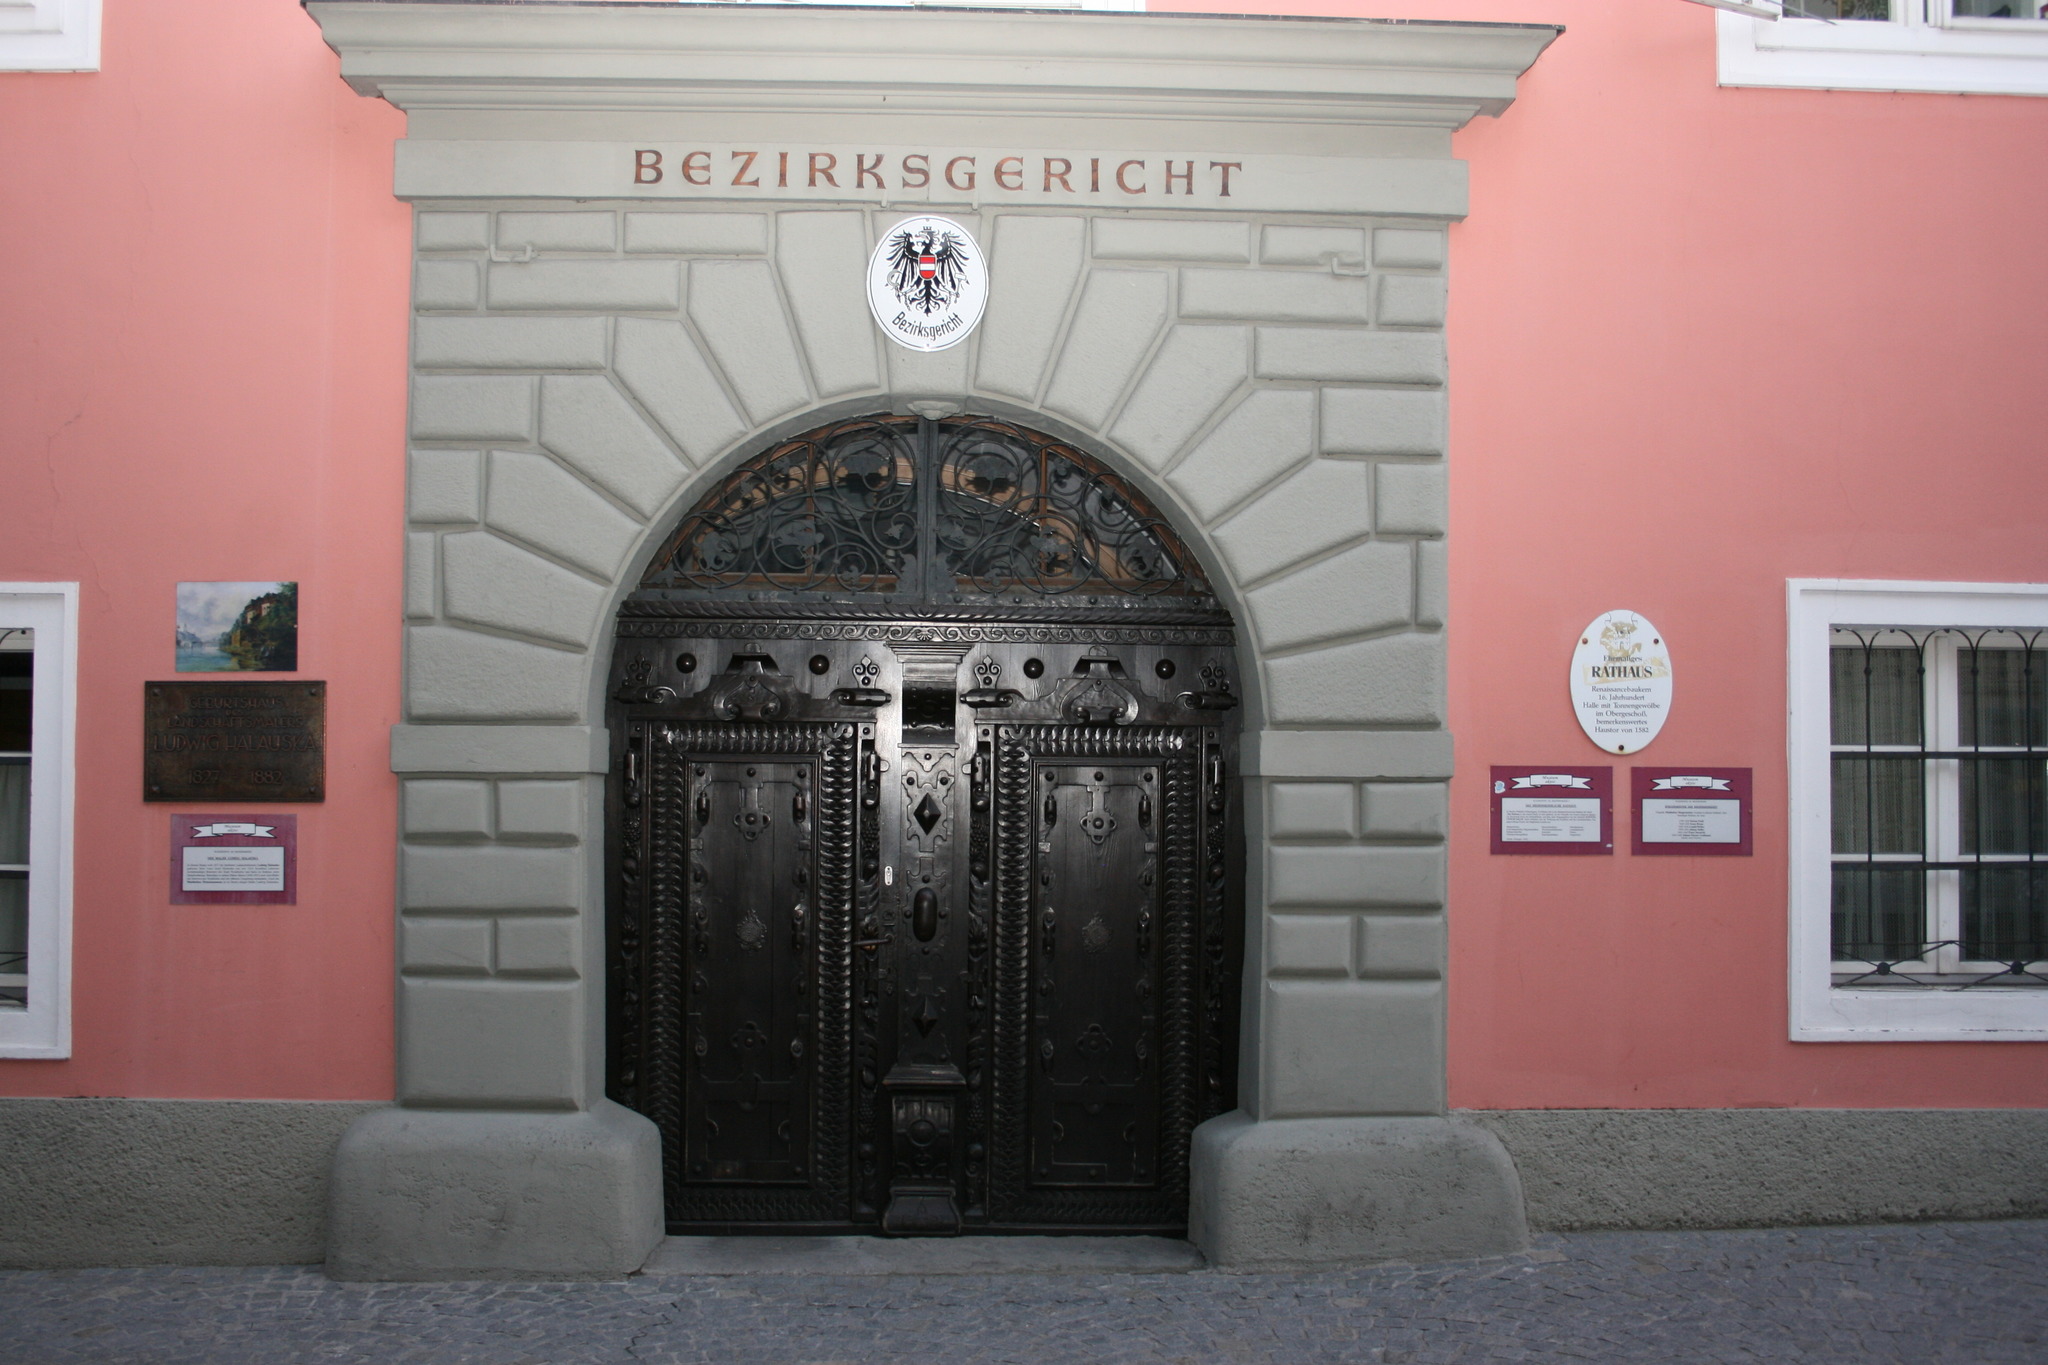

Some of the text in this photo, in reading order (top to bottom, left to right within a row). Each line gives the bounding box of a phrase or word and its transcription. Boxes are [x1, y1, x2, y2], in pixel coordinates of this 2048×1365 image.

[633, 149, 1243, 197] BEZIRKSGERICHT
[891, 311, 964, 341] Bezirksgericht
[1603, 655, 1642, 663] Ehemaliges
[1592, 666, 1653, 678] RATHAUS
[1591, 685, 1652, 693] Renaissancebaukern
[190, 696, 284, 709] GEBURTSHAUS
[1613, 702, 1660, 710] Tonnengewölbe
[167, 716, 304, 729] LANDSCHAFTSMALERS
[153, 733, 317, 752] LUDWIG HALAUSKA
[188, 769, 220, 785] 1827
[251, 770, 283, 786] 1882
